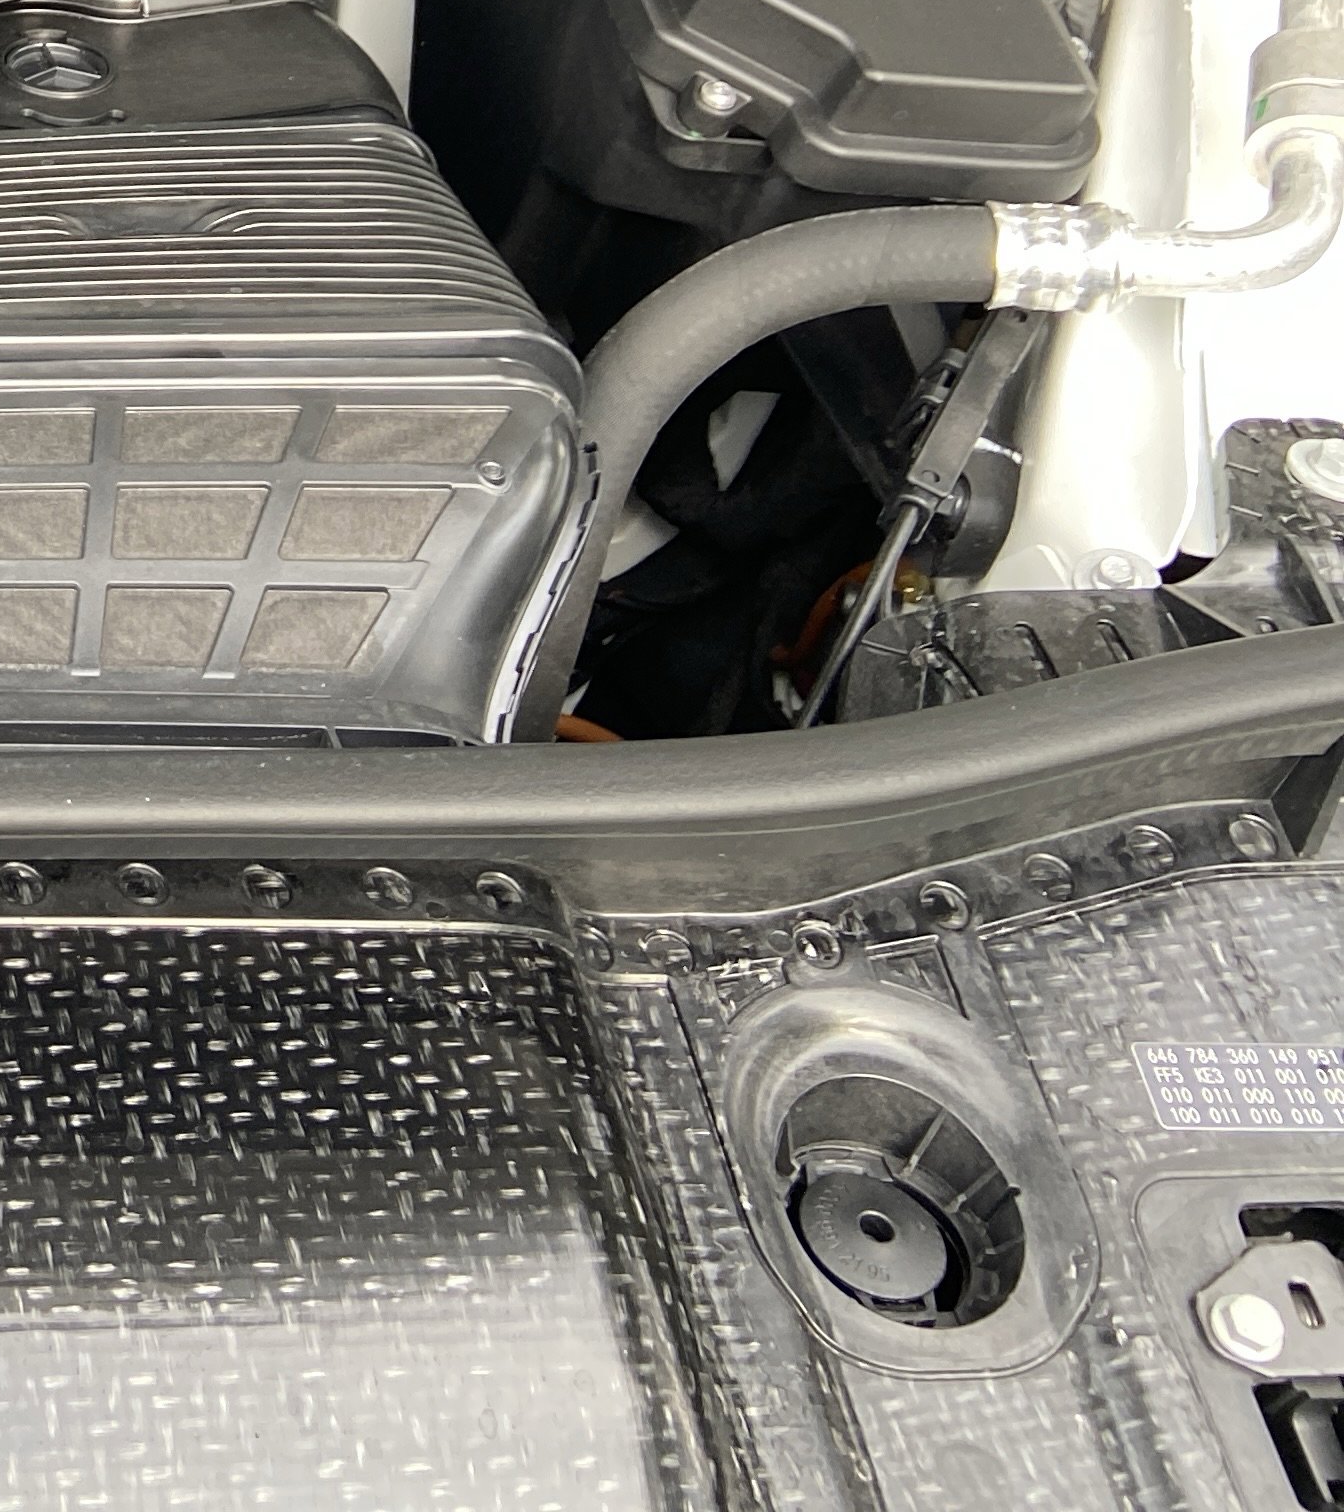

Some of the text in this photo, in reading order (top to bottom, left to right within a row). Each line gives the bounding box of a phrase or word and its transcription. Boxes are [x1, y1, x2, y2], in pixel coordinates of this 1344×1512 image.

[1147, 1048, 1339, 1065] 646 784 360 149 951
[1153, 1067, 1184, 1083] FF5
[1193, 1067, 1225, 1084] KE3
[1234, 1068, 1266, 1084] 011
[1275, 1068, 1307, 1084] 001
[1160, 1087, 1194, 1104] 010
[1201, 1087, 1233, 1104] 011
[1242, 1087, 1275, 1105] 000
[1284, 1088, 1316, 1105] 110
[1169, 1107, 1201, 1124] 100
[1209, 1107, 1241, 1124] 011
[1250, 1107, 1284, 1125] 010
[1291, 1107, 1325, 1125] 010
